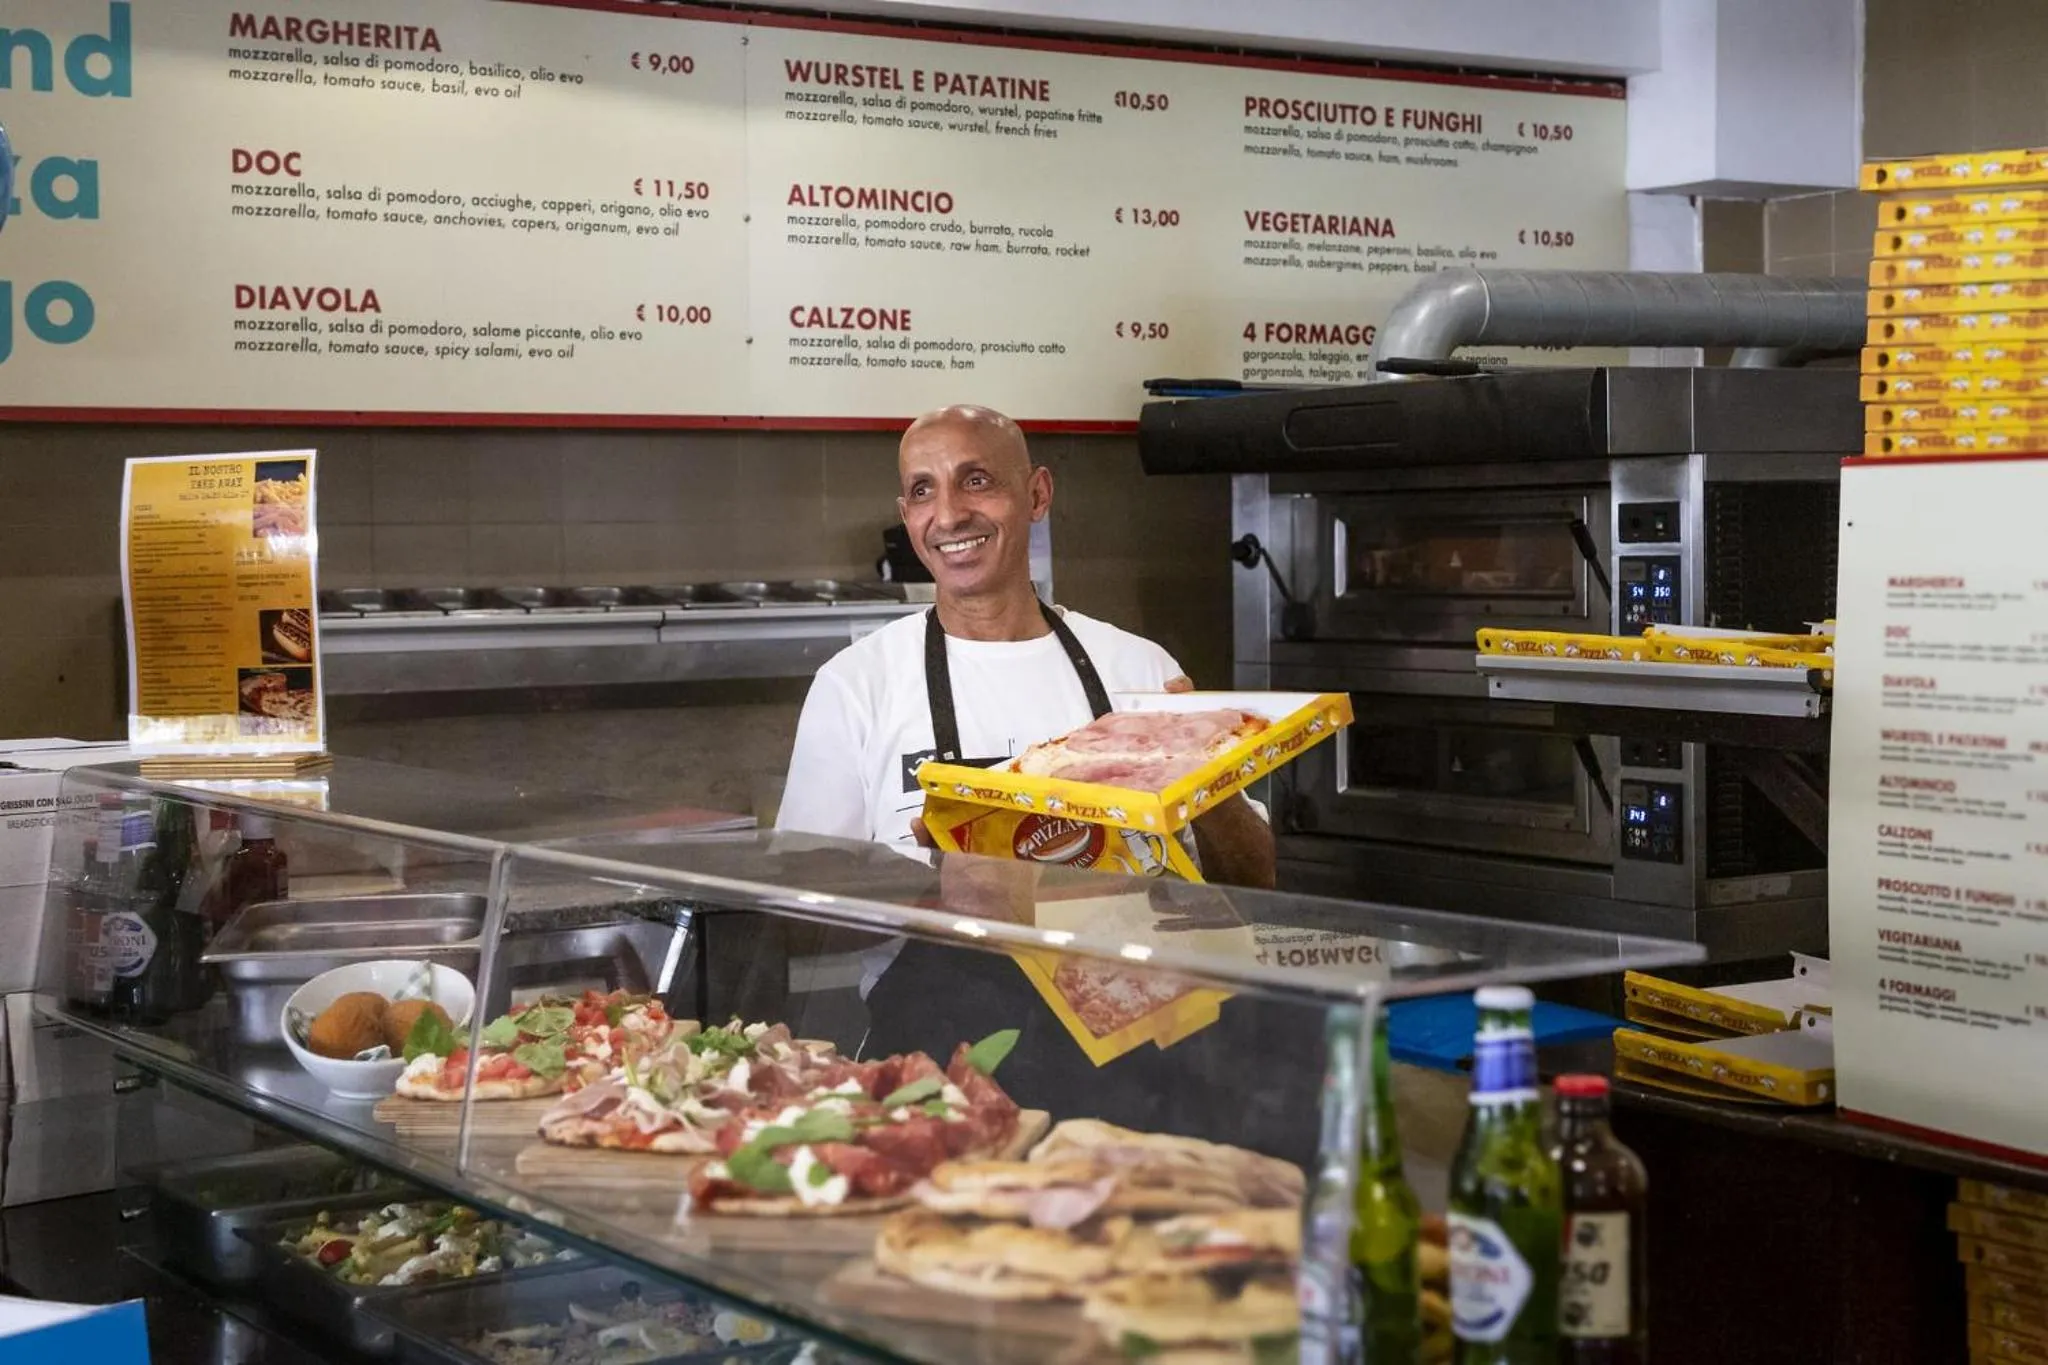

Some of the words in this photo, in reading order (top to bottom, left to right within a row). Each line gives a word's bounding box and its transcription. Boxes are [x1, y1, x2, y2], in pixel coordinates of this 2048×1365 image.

[229, 12, 442, 52] MARGHERITA
[228, 48, 317, 65] mozzarella,
[323, 52, 360, 66] salsa
[364, 55, 378, 67] di
[384, 59, 463, 76] pomodoro,
[469, 61, 524, 80] basilico,
[530, 66, 555, 81] olio
[559, 73, 583, 84] evo
[631, 52, 640, 69] €
[648, 53, 694, 74] 9,00
[228, 69, 316, 85] mozzarella,
[323, 72, 375, 87] tomato
[380, 80, 424, 92] sauce,
[474, 86, 499, 96] evo
[504, 84, 521, 97] oil
[784, 59, 904, 89] WURSTEL
[913, 70, 924, 91] E
[934, 72, 1049, 101] PATATINE
[785, 92, 857, 107] mozzarella,
[862, 95, 892, 107] salsa
[895, 96, 906, 108] di
[910, 100, 973, 115] pomodoro,
[1025, 109, 1074, 122] papatine
[1078, 108, 1102, 123] fritte
[1245, 96, 1376, 125] PROSCIUTTO
[1384, 107, 1394, 127] E
[1402, 109, 1481, 133] FUNGHI
[785, 110, 857, 124] mozzarella,
[862, 113, 904, 126] tomato
[908, 120, 943, 130] sauce,
[995, 121, 1030, 135] french
[1033, 124, 1057, 137] fries
[1532, 123, 1573, 140] 10,50
[232, 148, 301, 176] DOC
[634, 178, 642, 195] €
[654, 180, 709, 199] 11,50
[787, 184, 953, 213] ALTOMINCIO
[231, 184, 320, 200] mozzarella,
[326, 187, 362, 199] salsa
[367, 188, 381, 200] di
[386, 191, 465, 207] pomodoro,
[471, 194, 536, 211] acciughe,
[541, 199, 594, 214] capperi,
[600, 201, 654, 217] origano,
[659, 203, 682, 216] olio
[686, 209, 709, 218] evo
[232, 205, 320, 220] mozzarella,
[326, 207, 377, 220] tomato
[383, 212, 427, 224] sauce,
[511, 219, 559, 231] capers,
[565, 218, 630, 235] origanum,
[636, 225, 659, 234] evo
[663, 222, 679, 235] oil
[787, 215, 860, 228] mozzarella,
[864, 218, 926, 231] pomodoro
[929, 220, 965, 234] crudo,
[1018, 225, 1053, 237] rucola
[1115, 207, 1122, 222] €
[1132, 208, 1180, 226] 13,00
[1244, 210, 1395, 237] VEGETARIANA
[787, 234, 859, 247] mozzarella,
[864, 235, 906, 247] tomato
[910, 240, 945, 250] sauce,
[950, 242, 971, 250] raw
[1055, 244, 1090, 256] rocket
[1533, 230, 1574, 246] 10,50
[235, 284, 381, 312] DIAVOLA
[636, 304, 645, 320] €
[656, 305, 711, 324] 10,00
[790, 305, 910, 330] CALZONE
[234, 319, 322, 333] mozzarella,
[328, 320, 364, 332] salsa
[369, 320, 382, 333] di
[388, 322, 466, 338] pomodoro,
[472, 323, 520, 336] salame
[526, 324, 584, 340] piccante,
[590, 326, 614, 339] olio
[619, 331, 642, 340] evo
[1116, 322, 1124, 337] €
[1130, 322, 1168, 340] 9,50
[1243, 322, 1256, 341] 4
[234, 339, 321, 353] mozzarella,
[328, 340, 379, 353] tomato
[384, 344, 428, 355] sauce,
[435, 342, 470, 359] spicy
[474, 343, 522, 358] salami,
[528, 348, 552, 357] evo
[557, 344, 574, 358] oil
[789, 336, 862, 349] mozzarella,
[866, 337, 895, 349] salsa
[898, 337, 910, 349] di
[913, 338, 976, 352] pomodoro,
[980, 340, 1034, 354] prosciutto
[1038, 342, 1065, 353] cotto
[789, 354, 861, 367] mozzarella,
[866, 355, 907, 367] tomato
[910, 359, 945, 368] sauce,
[950, 356, 974, 368] ham
[1654, 586, 1671, 597] 350
[974, 788, 1016, 804] PIZZA
[1066, 802, 1110, 818] PIZZA
[1032, 818, 1078, 846] PIZZA
[1878, 929, 1962, 952] VEGETARIANA
[1889, 979, 1956, 1001] FORMAGGI
